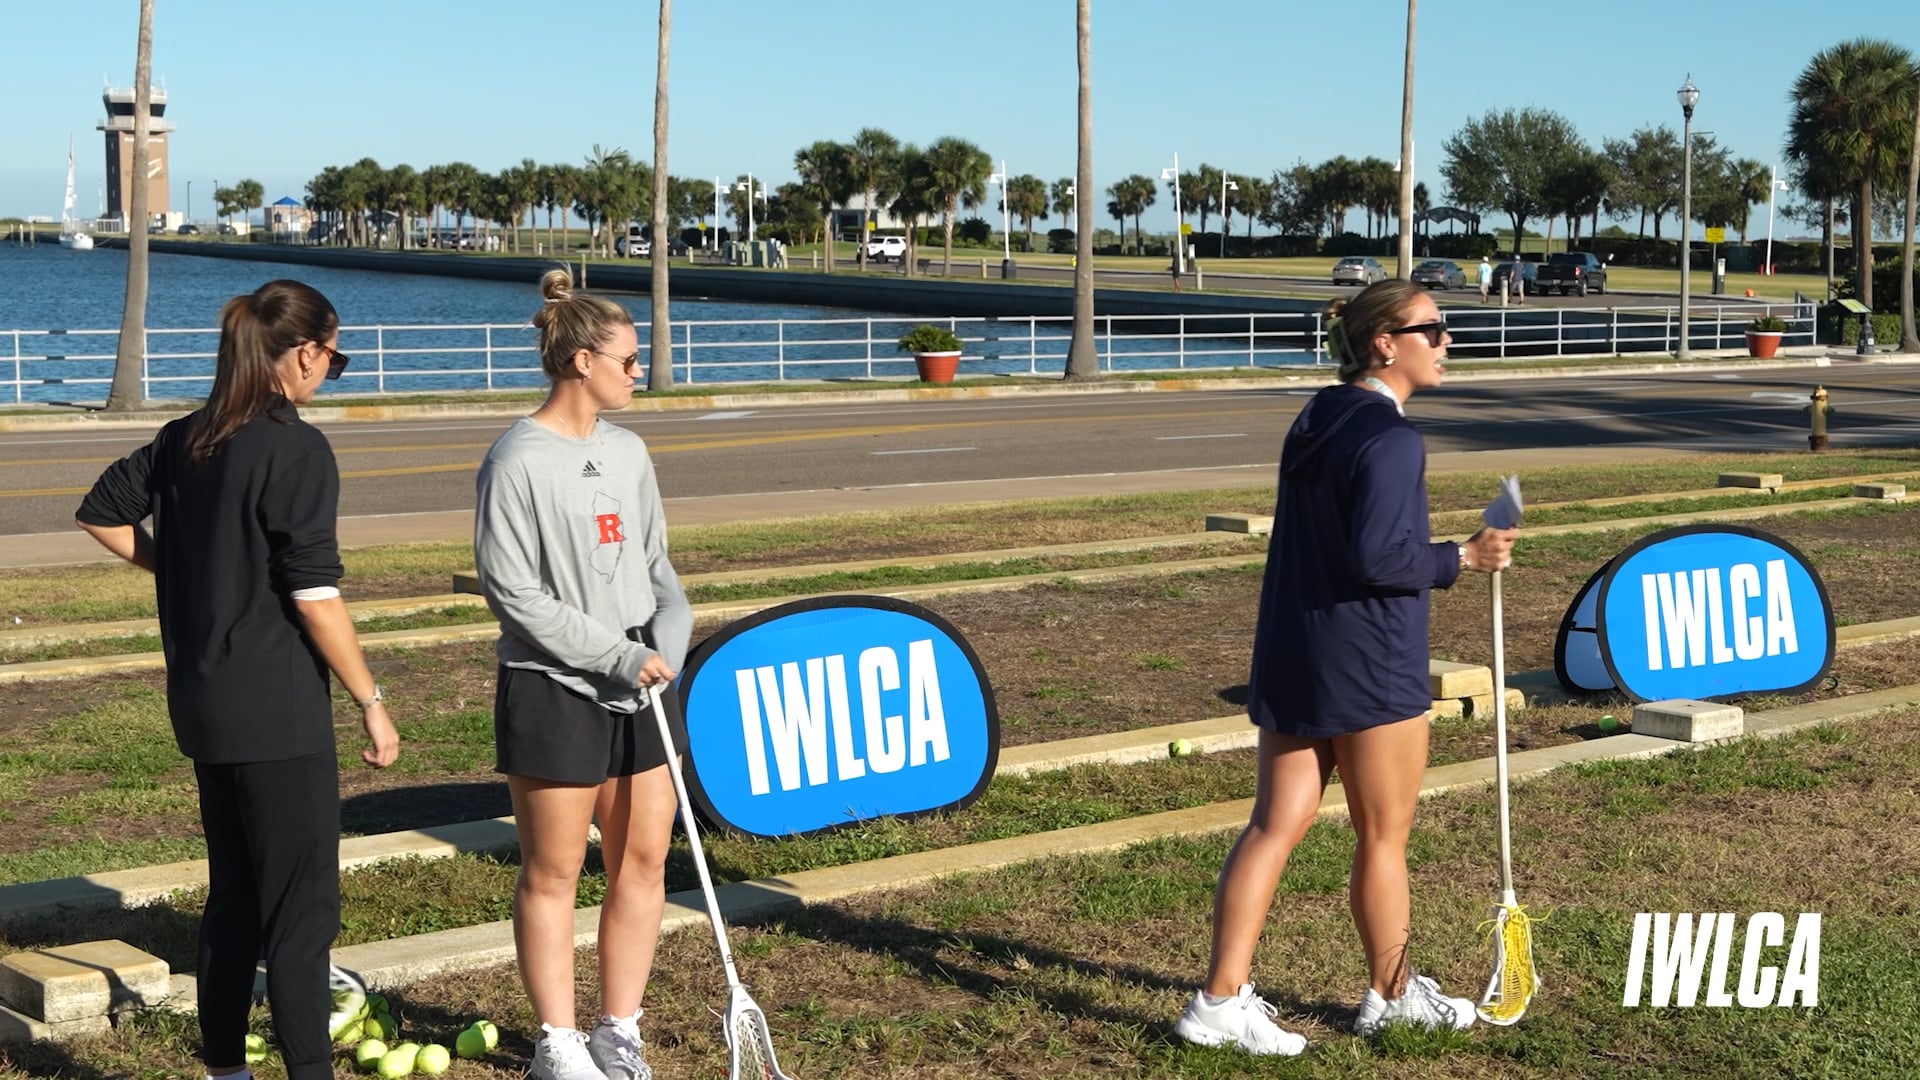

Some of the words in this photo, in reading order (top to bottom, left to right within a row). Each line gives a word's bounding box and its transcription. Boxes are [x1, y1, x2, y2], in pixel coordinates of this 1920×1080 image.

[595, 513, 625, 545] R
[1641, 559, 1799, 671] IWLCA
[735, 639, 950, 796] IWLCA
